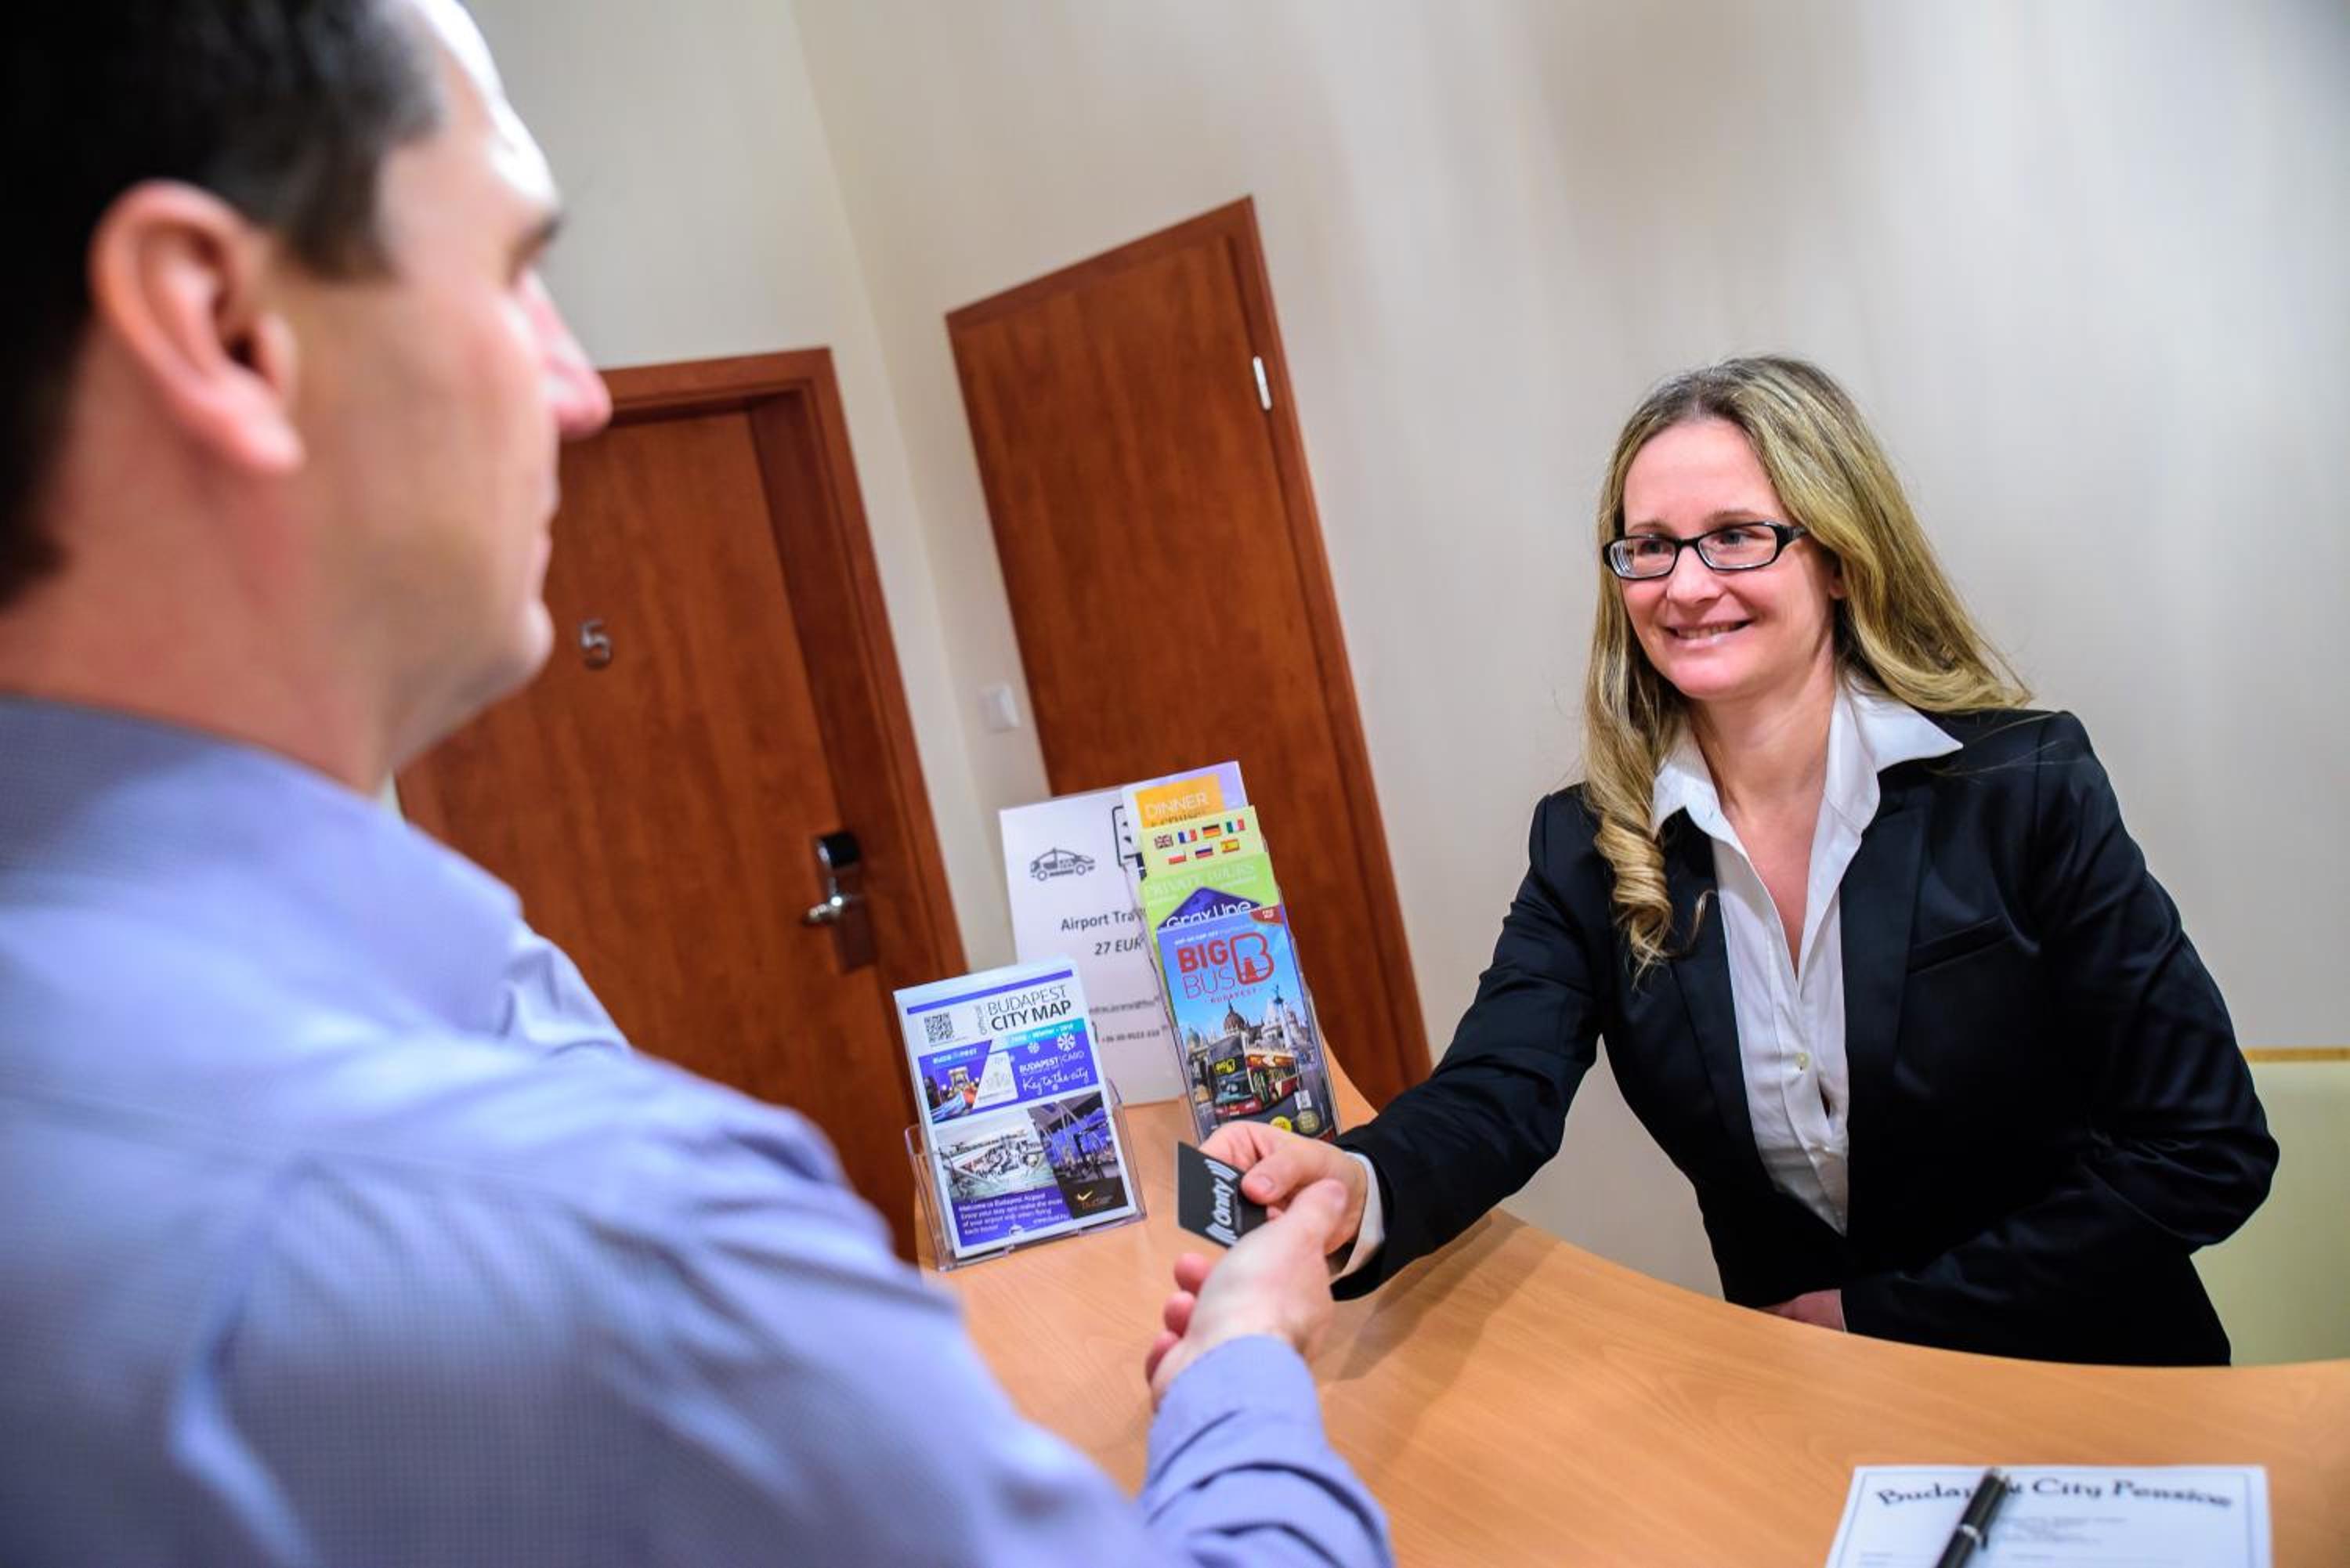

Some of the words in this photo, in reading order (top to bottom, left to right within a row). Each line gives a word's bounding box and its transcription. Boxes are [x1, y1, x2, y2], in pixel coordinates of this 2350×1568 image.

[580, 618, 612, 668] 5
[1144, 790, 1210, 819] DINNER
[1061, 913, 1109, 932] Airport
[1094, 941, 1112, 956] 27
[1177, 939, 1229, 974] BIG
[1182, 966, 1235, 1000] BUS
[987, 984, 1067, 1016] BUDAPEST
[991, 1009, 1028, 1032] CITY
[1032, 999, 1072, 1022] MAP
[1019, 1055, 1058, 1073] BUDAPEST
[1021, 1076, 1043, 1096] Key
[2032, 1476, 2102, 1499] City
